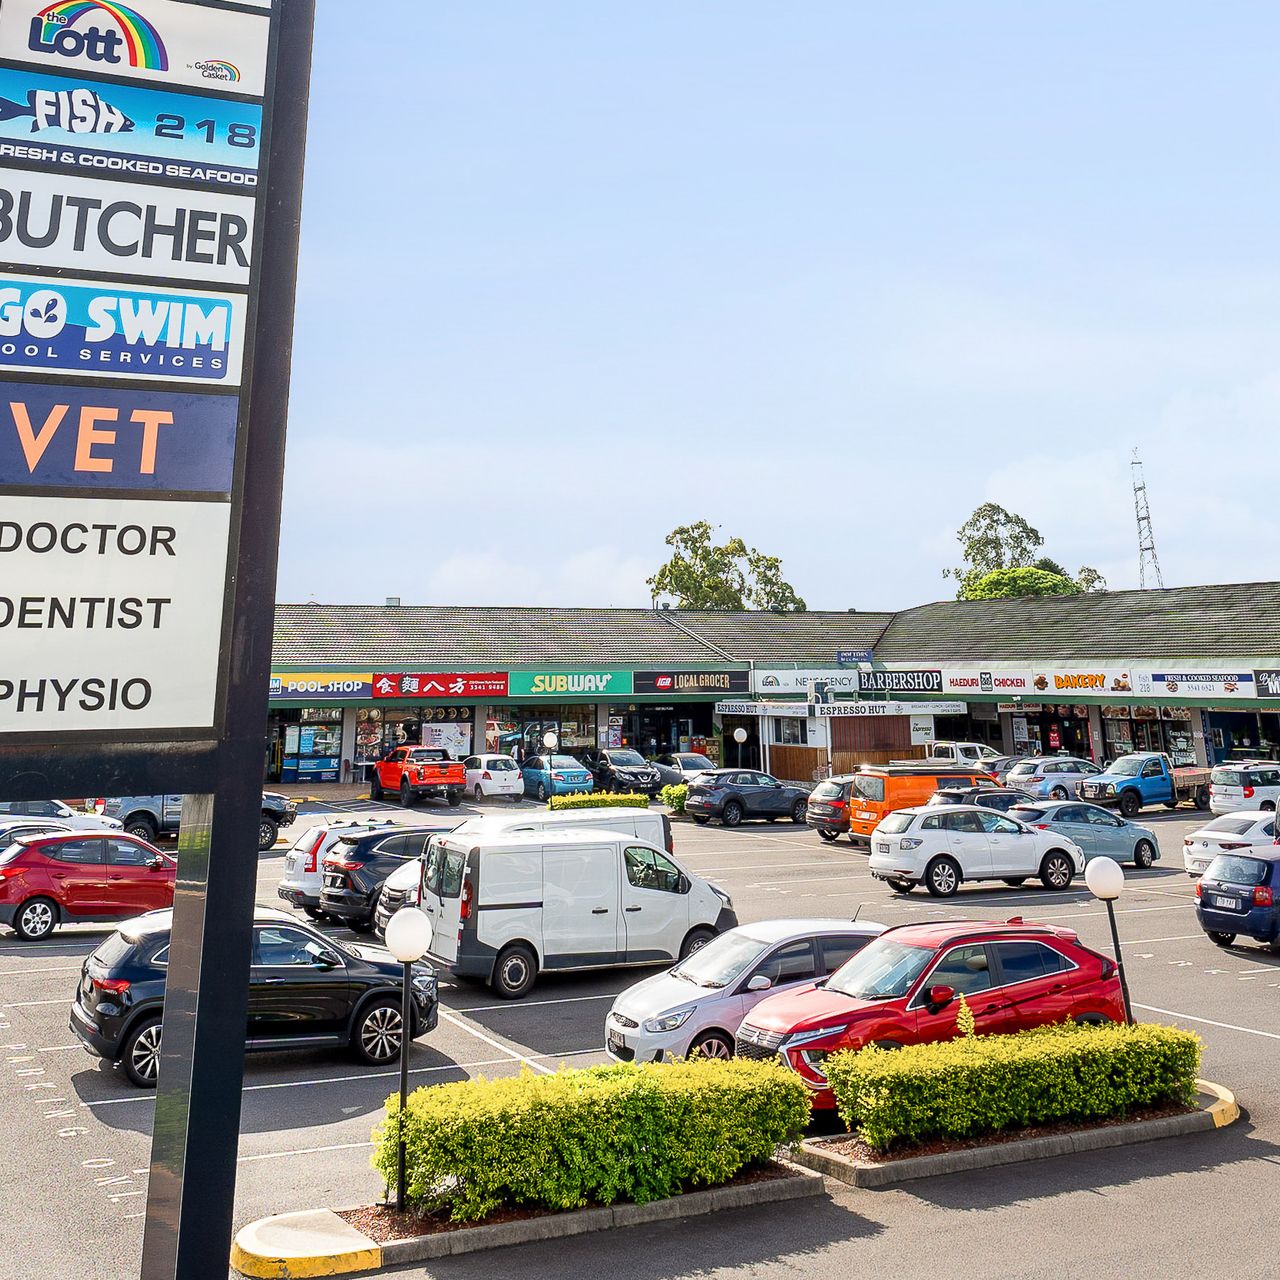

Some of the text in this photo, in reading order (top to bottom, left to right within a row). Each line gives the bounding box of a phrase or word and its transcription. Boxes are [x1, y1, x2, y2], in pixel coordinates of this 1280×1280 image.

[46, 11, 67, 24] the
[28, 16, 123, 64] Lott
[194, 61, 225, 74] Golden
[201, 69, 229, 82] Casket
[35, 88, 257, 149] FISH 218
[60, 150, 76, 165] &
[78, 153, 163, 176] COOKED
[165, 165, 258, 186] SEAFOOD
[83, 295, 227, 351] SWIM
[80, 347, 224, 370] SERVICES
[9, 402, 174, 475] VET
[530, 673, 613, 694] SUBWAY
[656, 674, 730, 689] IGA LOCAL GROCER
[861, 672, 941, 690] BARBERSHOP
[949, 678, 980, 687] HAEDURI
[994, 678, 1026, 688] CHICKEN
[1053, 673, 1107, 690] BAKERY
[1212, 674, 1239, 682] SEAFOOD
[288, 681, 362, 693] POOL SHOP
[717, 704, 758, 713] ESPRESSO HUT
[820, 705, 887, 715] ESPRESSO HUT
